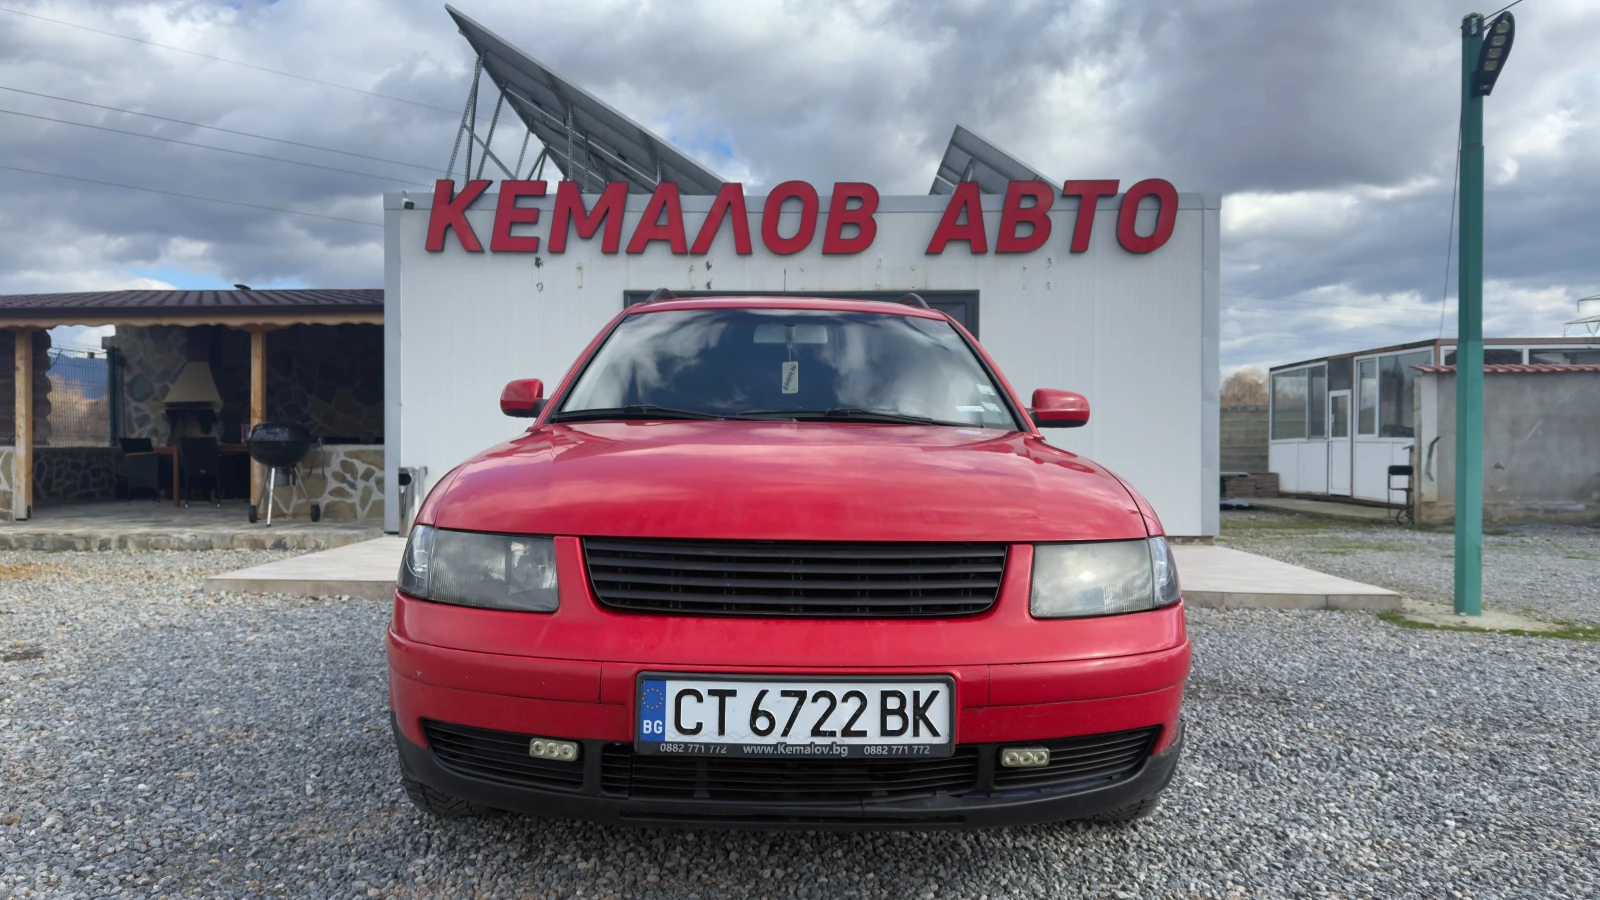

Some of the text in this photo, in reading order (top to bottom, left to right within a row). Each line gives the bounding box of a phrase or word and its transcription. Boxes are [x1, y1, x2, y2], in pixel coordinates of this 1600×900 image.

[425, 178, 1179, 255] КЕМАЛОВ АВТО
[674, 688, 941, 737] CT 6722 BK
[642, 719, 663, 735] BG
[660, 743, 727, 754] 0882 771 772
[743, 742, 849, 757] www.Kemalov.bg
[864, 745, 930, 755] 0882 771 772
